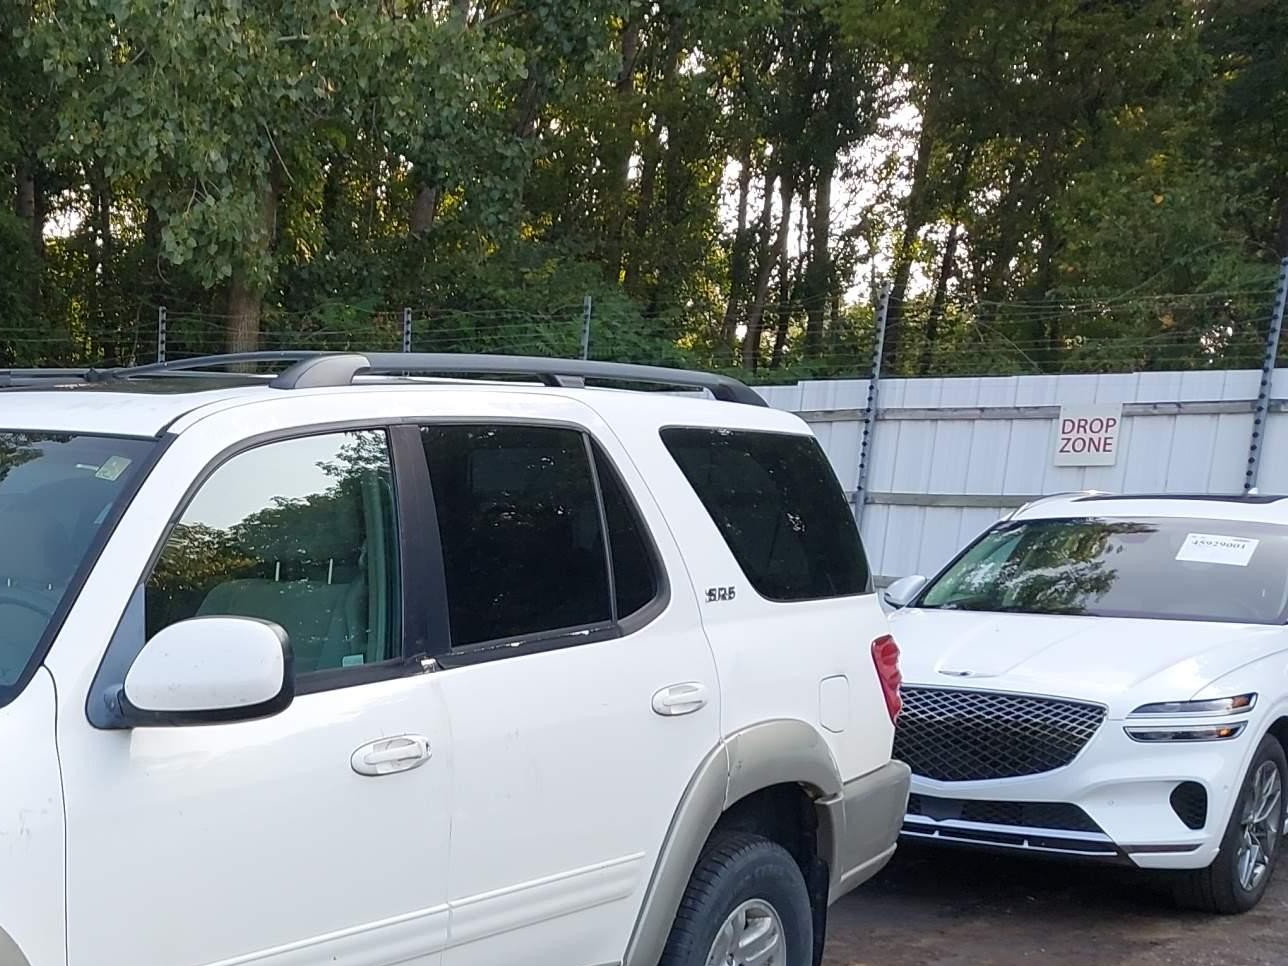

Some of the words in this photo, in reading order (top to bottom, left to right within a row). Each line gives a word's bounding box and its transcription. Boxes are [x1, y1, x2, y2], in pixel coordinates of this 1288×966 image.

[1061, 417, 1117, 435] DROP
[1059, 437, 1114, 453] ZONE
[705, 586, 736, 603] SR5
